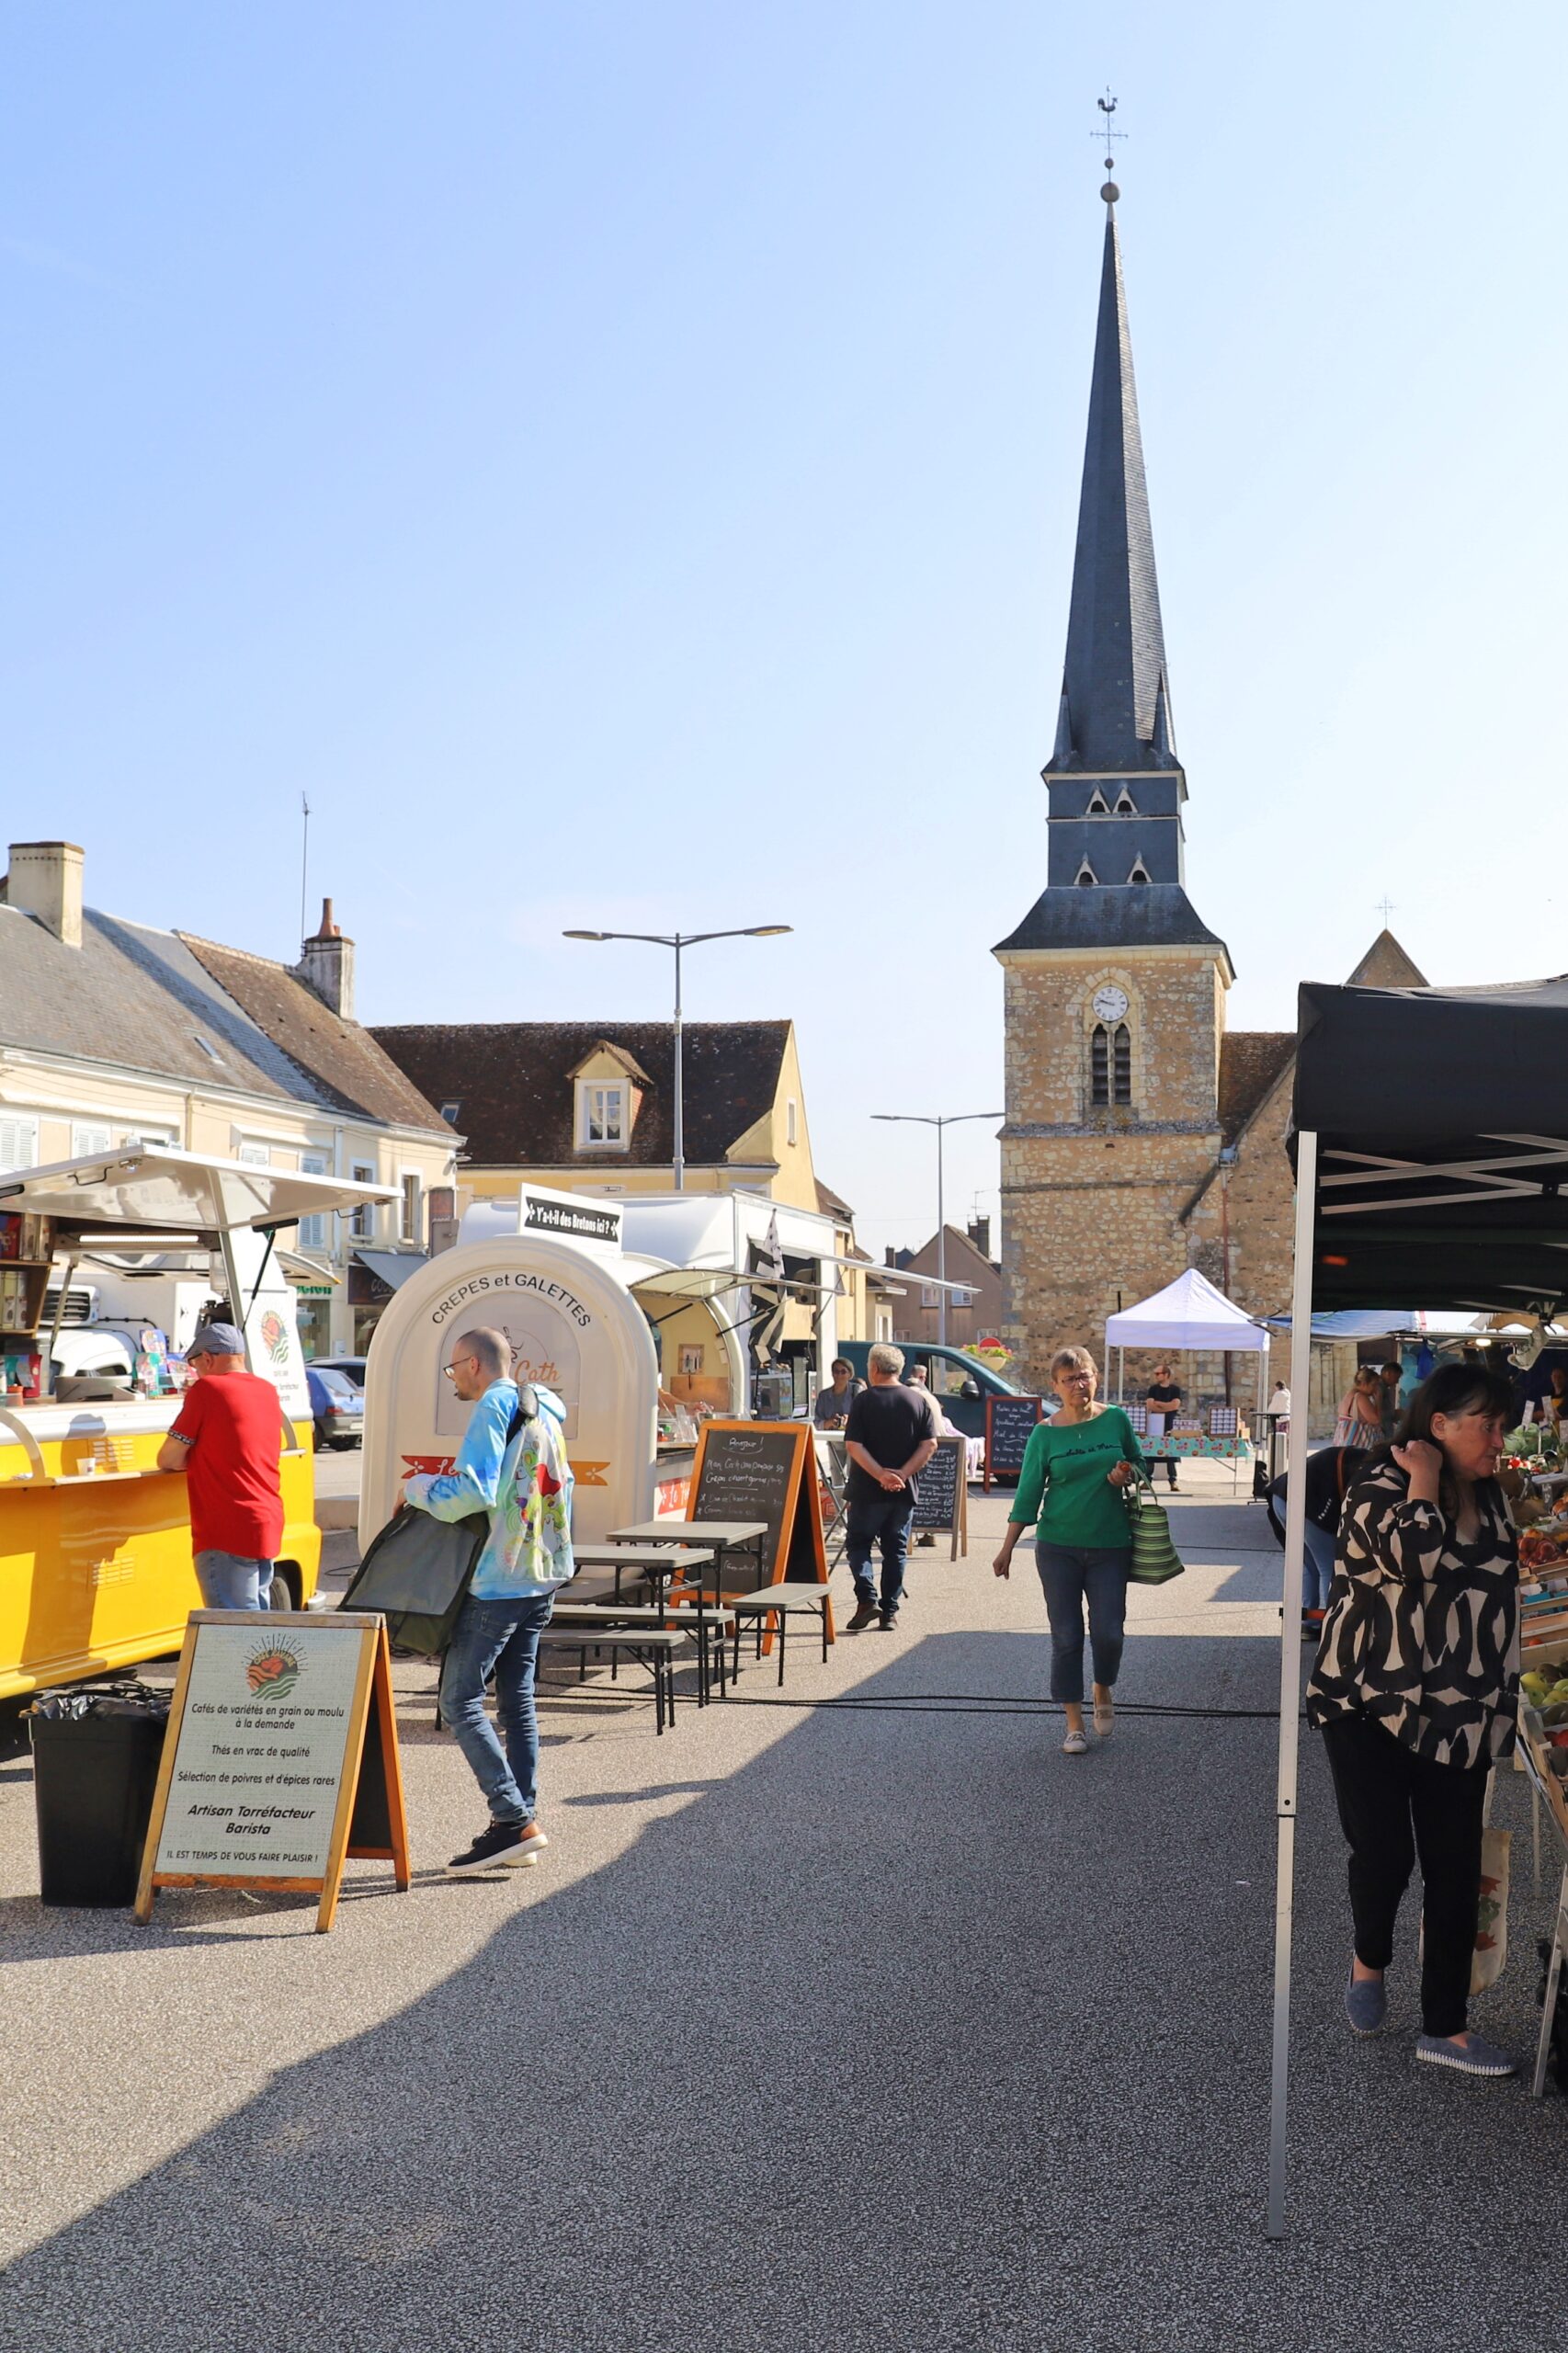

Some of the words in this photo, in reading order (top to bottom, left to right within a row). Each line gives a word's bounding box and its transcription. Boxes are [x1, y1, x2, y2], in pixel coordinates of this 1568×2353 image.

[560, 1211, 572, 1227] des
[572, 1214, 596, 1231] Bretons
[597, 1218, 605, 1233] ici
[605, 1220, 610, 1234] ?
[432, 1277, 490, 1324] CREPES
[494, 1274, 510, 1286] et
[515, 1274, 591, 1327] GALETTES
[514, 1360, 561, 1386] Cath
[192, 1703, 214, 1714] Cafés
[217, 1704, 228, 1714] de
[230, 1704, 263, 1715] variétés
[279, 1706, 301, 1718] grain
[317, 1707, 344, 1717] moulu
[236, 1718, 241, 1728] à
[244, 1718, 252, 1728] la
[255, 1719, 295, 1729] demande
[212, 1745, 230, 1755] Thés
[267, 1746, 277, 1756] de
[280, 1747, 310, 1759] qualité
[178, 1771, 216, 1782] Sélection
[219, 1773, 229, 1783] de
[232, 1774, 262, 1785] poivres
[265, 1774, 274, 1783] et
[276, 1774, 310, 1786] d'épices
[188, 1805, 233, 1816] Artisan
[237, 1806, 316, 1819] Torréfacteur
[226, 1822, 271, 1834] Barista
[167, 1851, 173, 1859] IL
[176, 1851, 189, 1859] EST
[192, 1851, 218, 1860] TEMPS
[234, 1852, 256, 1861] VOUS
[258, 1853, 281, 1861] FAIRE
[283, 1853, 312, 1862] PLAISIR
